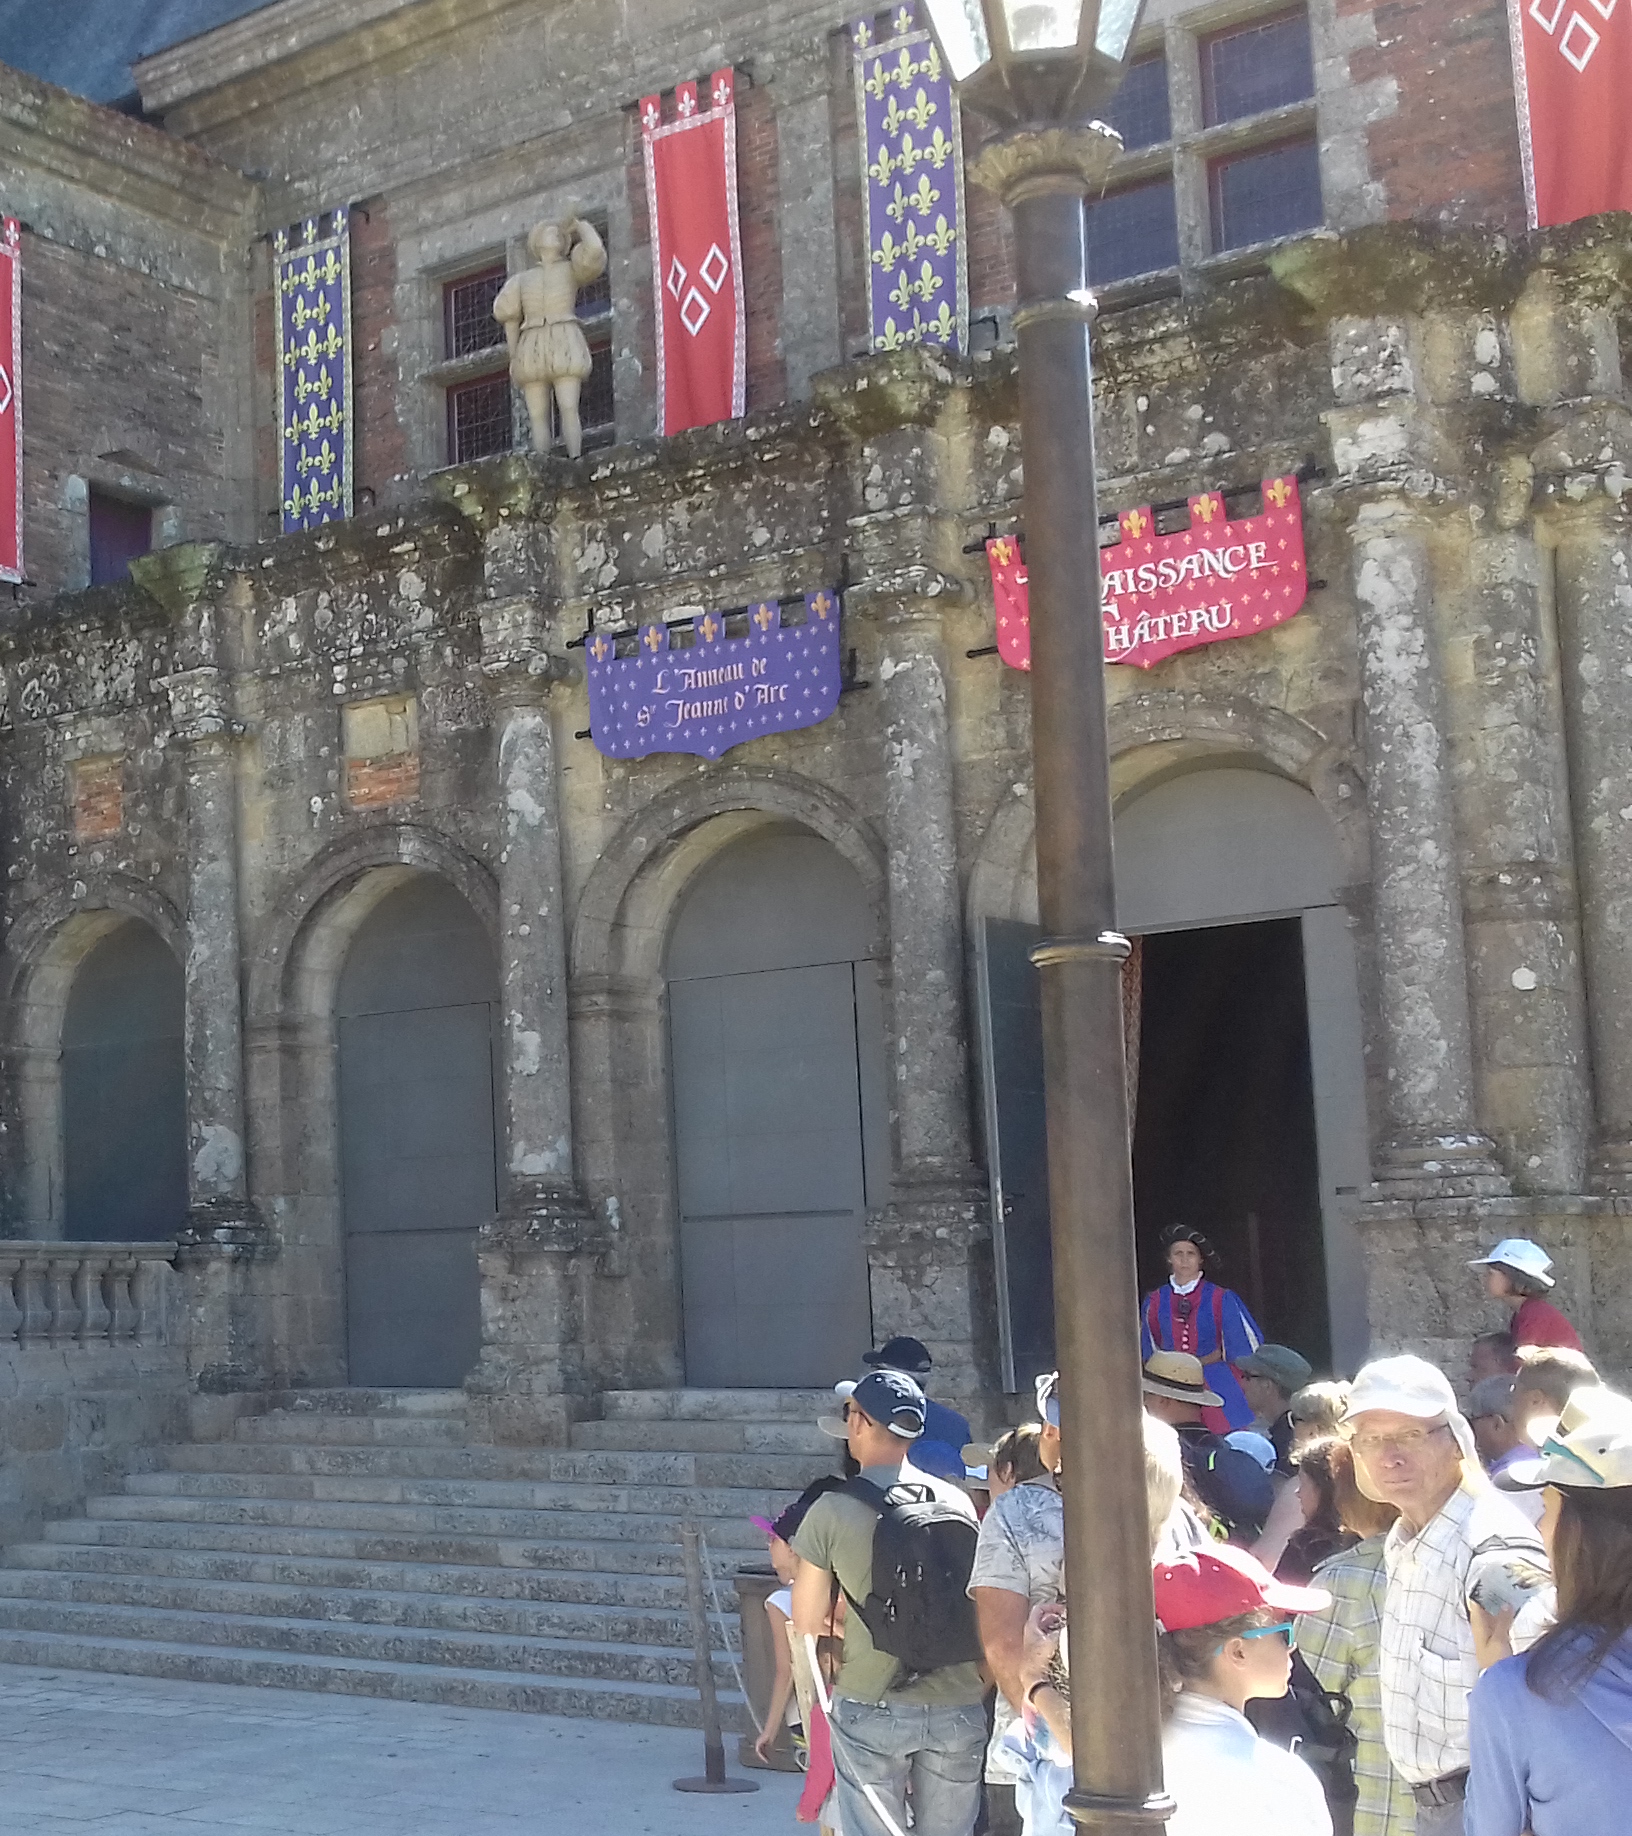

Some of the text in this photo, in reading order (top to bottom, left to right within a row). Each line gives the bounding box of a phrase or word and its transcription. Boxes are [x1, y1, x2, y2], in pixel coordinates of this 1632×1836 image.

[1101, 541, 1278, 599] AISSANCE
[650, 656, 768, 695] L'Anneau de
[663, 695, 729, 729] Jeanne
